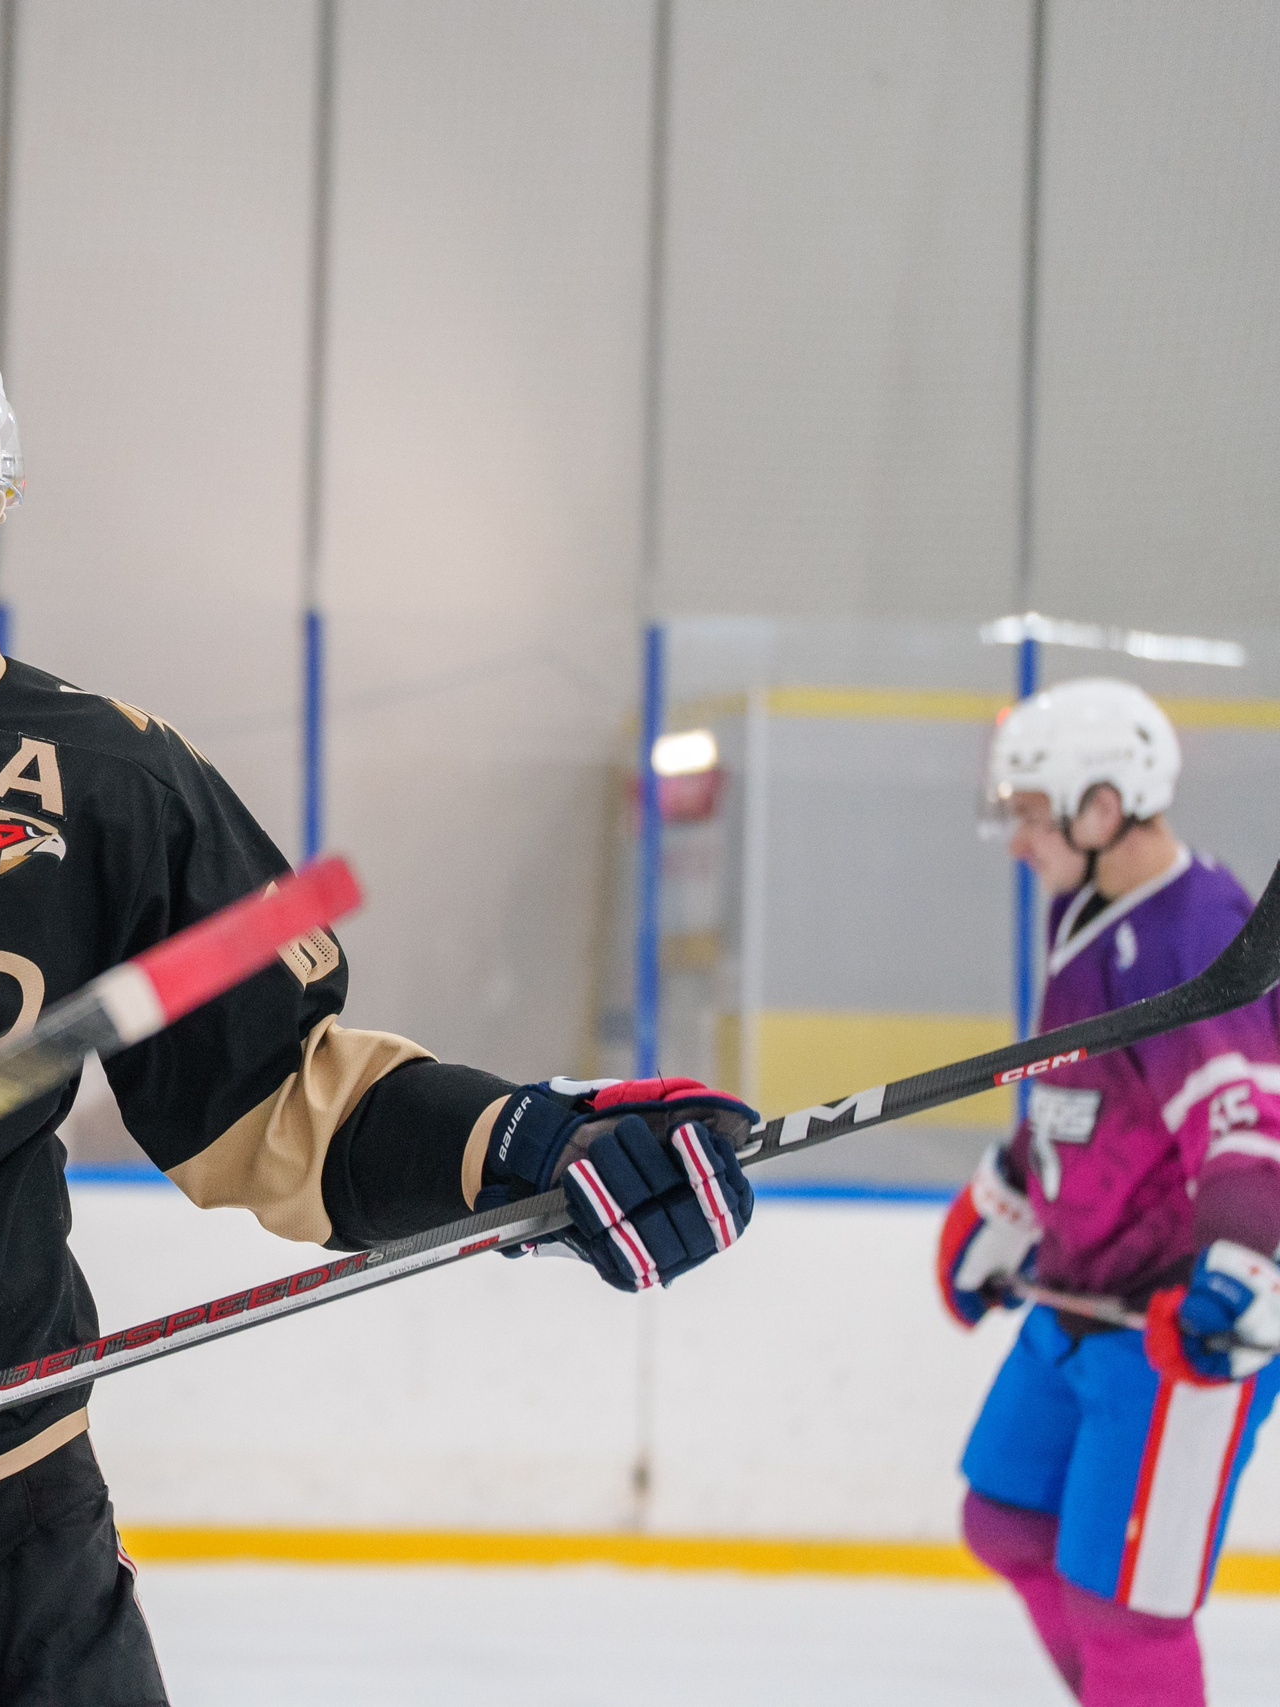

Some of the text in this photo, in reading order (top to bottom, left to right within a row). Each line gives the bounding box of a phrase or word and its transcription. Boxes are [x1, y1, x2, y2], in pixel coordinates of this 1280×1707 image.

[1001, 1050, 1081, 1084] CCM
[497, 1095, 533, 1163] BAUER
[0, 1267, 330, 1392] JETSPEED
